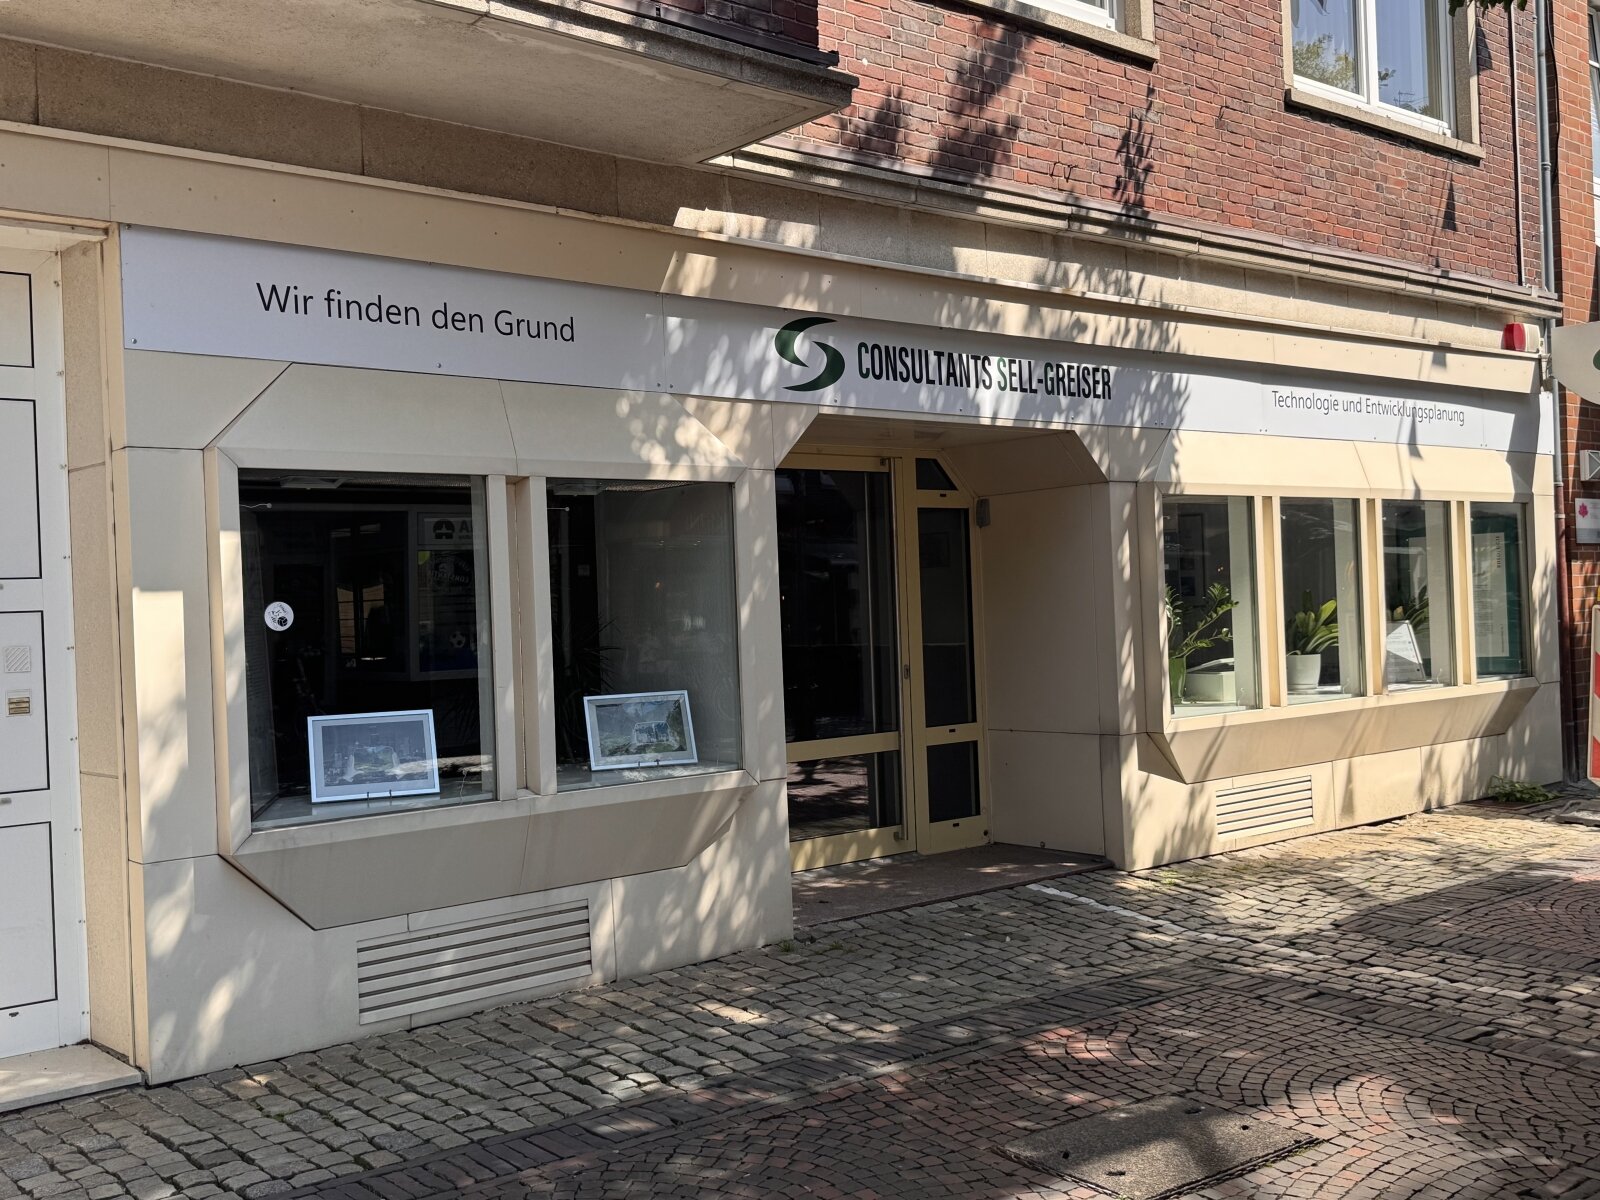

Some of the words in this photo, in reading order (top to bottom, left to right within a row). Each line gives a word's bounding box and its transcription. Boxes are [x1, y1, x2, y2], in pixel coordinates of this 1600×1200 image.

[255, 281, 314, 316] Wir
[323, 288, 421, 327] finden
[431, 301, 484, 334] den
[494, 309, 576, 343] Grund
[857, 341, 992, 390] CONSULTANTS
[997, 356, 1112, 400] SELL-GREISER
[1271, 390, 1340, 416] Technologie
[1341, 397, 1363, 414] und
[1365, 398, 1466, 427] Entwicklungsplanung
